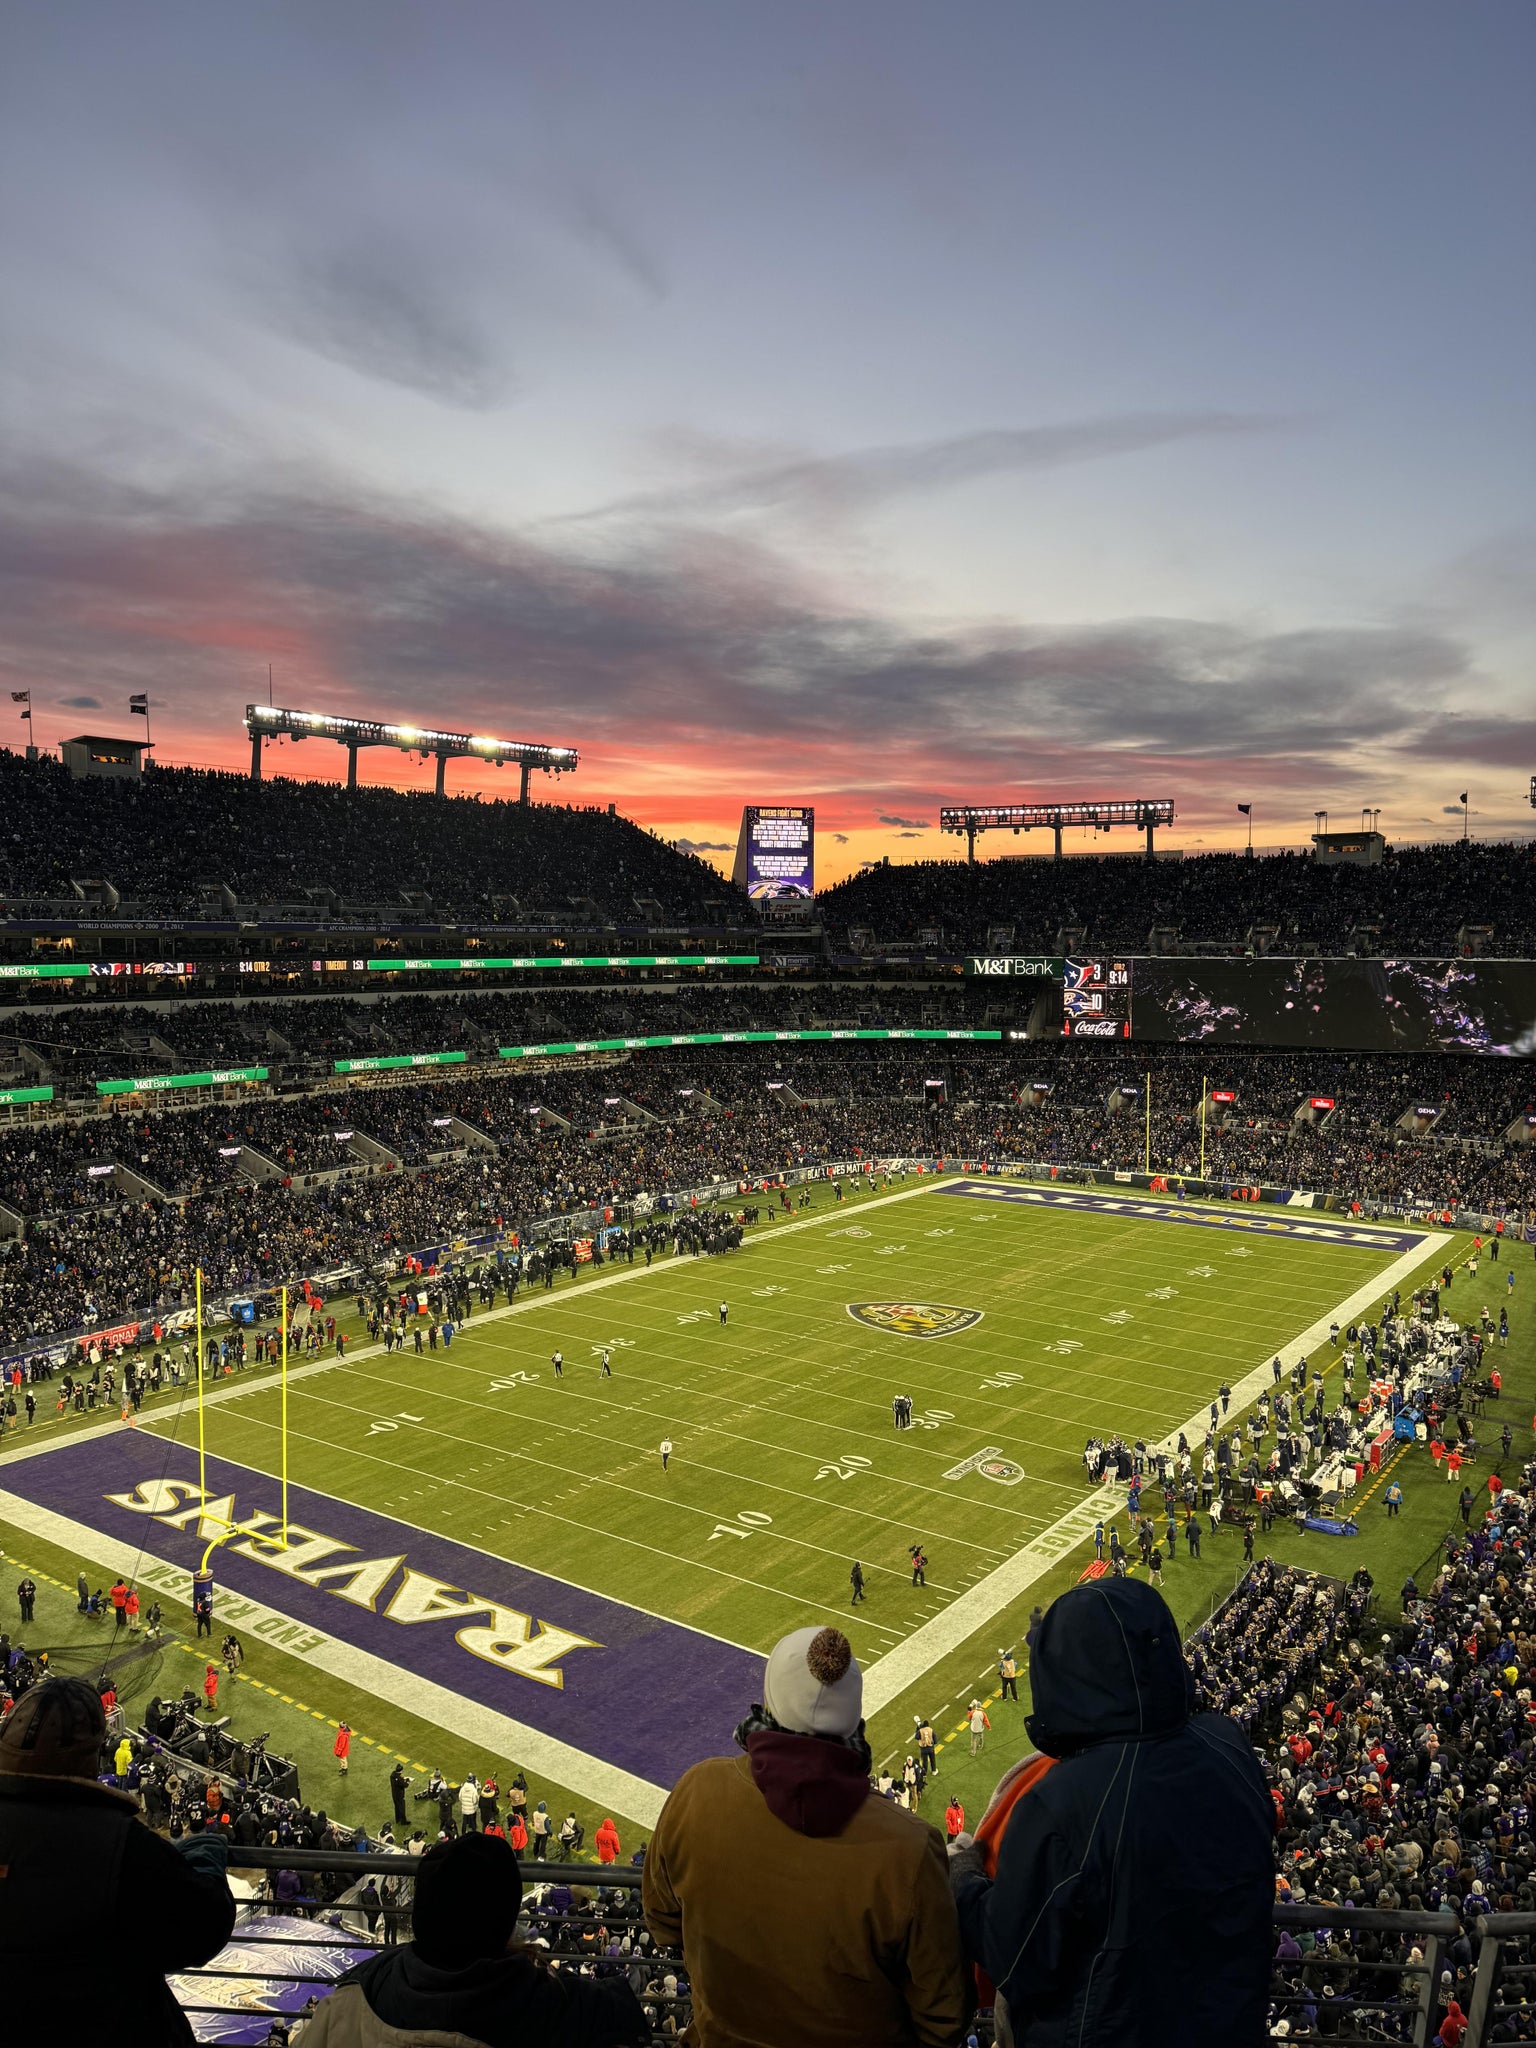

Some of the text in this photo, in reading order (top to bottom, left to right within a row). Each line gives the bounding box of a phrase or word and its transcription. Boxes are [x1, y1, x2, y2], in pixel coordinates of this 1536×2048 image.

[0, 967, 40, 976] M&T Bank
[126, 963, 130, 974] 3
[240, 962, 252, 972] 9:14
[254, 962, 270, 972] QTR 2
[325, 960, 347, 970] TIMEOUT
[352, 960, 364, 970] 1:53
[973, 959, 1054, 975] M&T Bank
[1094, 964, 1100, 980] 3
[1110, 971, 1128, 984] 9:14
[1092, 994, 1102, 1010] 10
[1074, 1021, 1118, 1036] Coca-Cola
[365, 1060, 380, 1068] Bank
[426, 1056, 440, 1064] Bank
[230, 1072, 248, 1080] Bank
[153, 1078, 172, 1088] Bank
[0, 1093, 14, 1102] ank
[827, 1164, 845, 1176] LVES
[846, 1162, 874, 1174] MATTR
[996, 1164, 1022, 1174] RAVENS
[720, 1186, 736, 1196] RAVENS
[955, 1186, 1403, 1247] BALTIMORE
[816, 1264, 848, 1275] 40
[1145, 1287, 1180, 1300] 30
[677, 1309, 713, 1325] 40
[1100, 1310, 1134, 1325] 40
[592, 1338, 636, 1356] 30
[1050, 1339, 1084, 1356] 50
[490, 1370, 540, 1391] 20
[983, 1371, 1024, 1390] 40
[370, 1412, 425, 1434] 10
[913, 1409, 956, 1430] 30
[818, 1455, 872, 1480] 20
[713, 1510, 773, 1540] 10
[1030, 1499, 1117, 1559] CHANGE
[102, 1478, 605, 1690] RAVENS
[139, 1558, 328, 1654] END RAISM
[190, 1811, 202, 1820] 92
[262, 1804, 268, 1814] 8
[296, 1835, 302, 1844] 4
